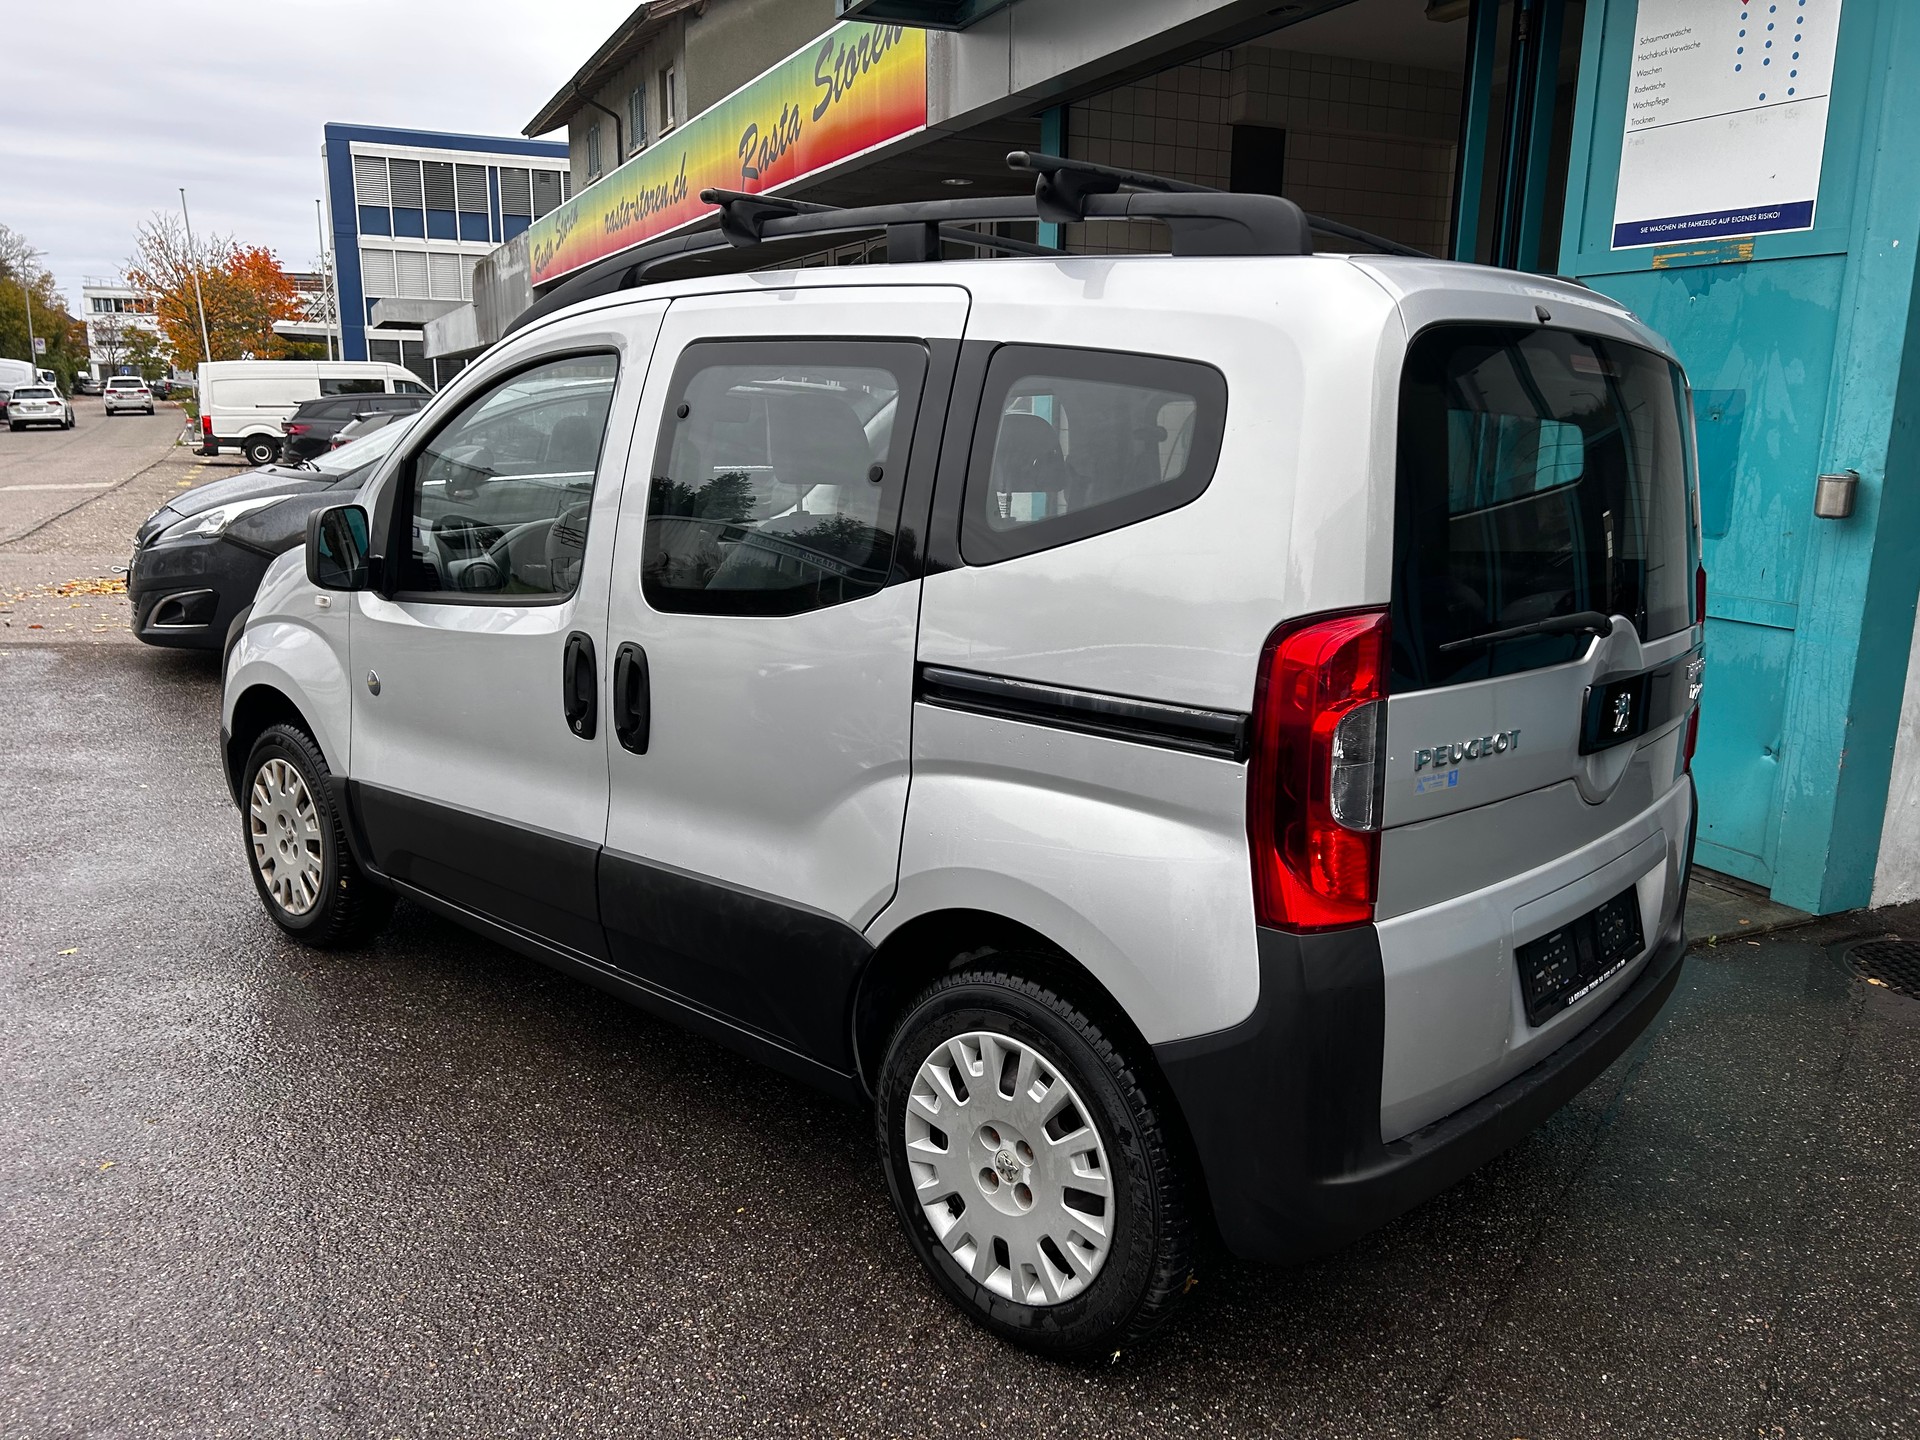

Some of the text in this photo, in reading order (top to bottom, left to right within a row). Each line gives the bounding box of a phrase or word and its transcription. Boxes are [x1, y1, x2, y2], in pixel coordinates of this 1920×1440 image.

[1636, 66, 1663, 78] Waschen
[739, 23, 904, 187] Rasta Storen
[1632, 96, 1670, 110] Wachspflege
[1631, 115, 1656, 126] Trocknen
[603, 151, 689, 235] rasta-storen.ch
[534, 203, 579, 275] Rasta Storen
[1640, 226, 1649, 234] SIE
[1649, 223, 1677, 232] WASCHEN
[1687, 218, 1718, 228] FAHRZEUG
[1718, 216, 1730, 225] AUF
[1731, 213, 1757, 223] EIGENES
[1757, 211, 1781, 220] RISIKO!
[1413, 728, 1522, 772] PEUGEOT
